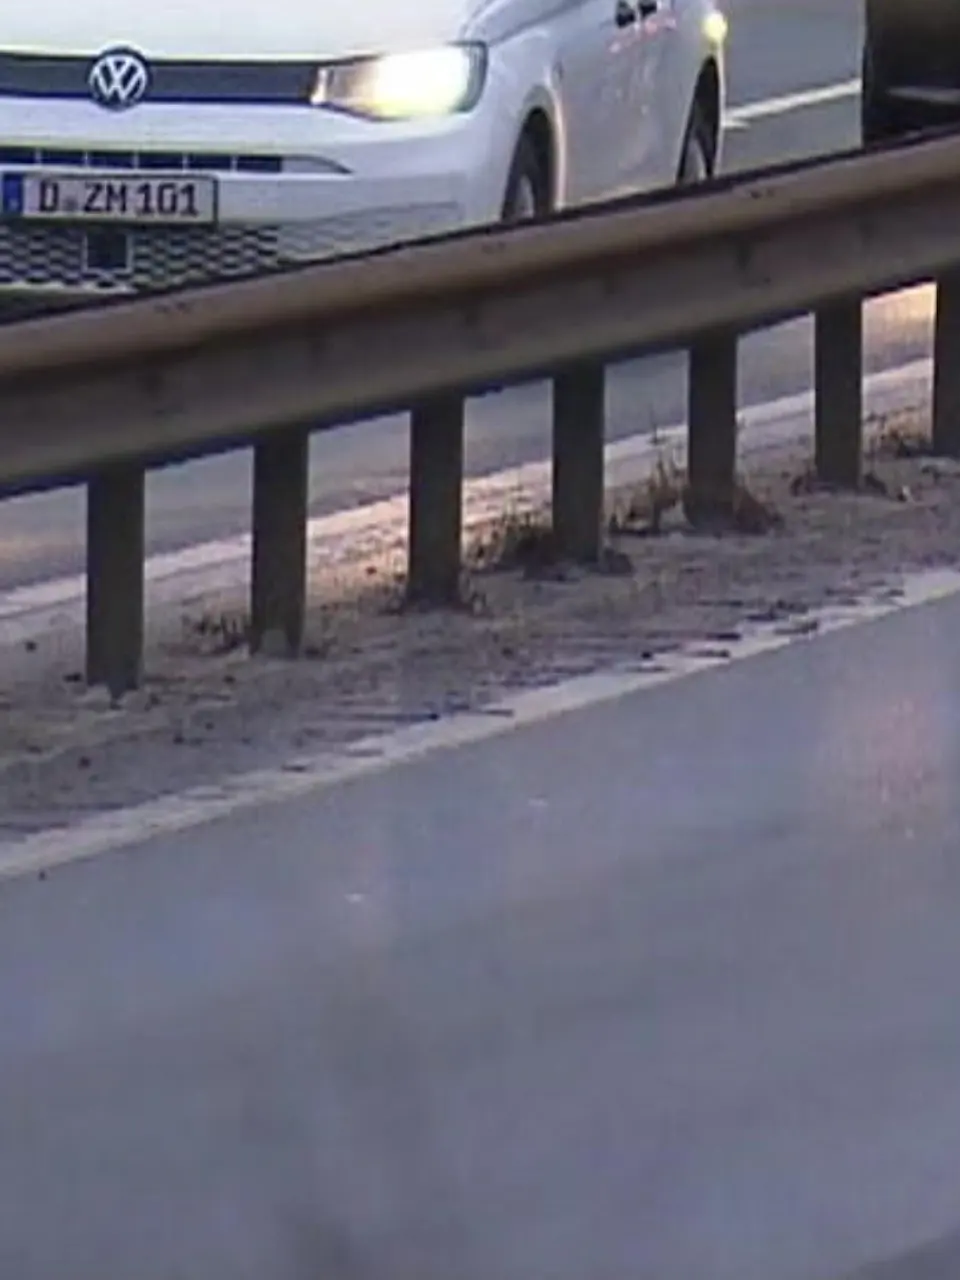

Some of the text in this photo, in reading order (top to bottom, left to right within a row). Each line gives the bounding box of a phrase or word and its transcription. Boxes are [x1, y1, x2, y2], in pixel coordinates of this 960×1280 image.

[38, 181, 199, 217] D ZM 101
